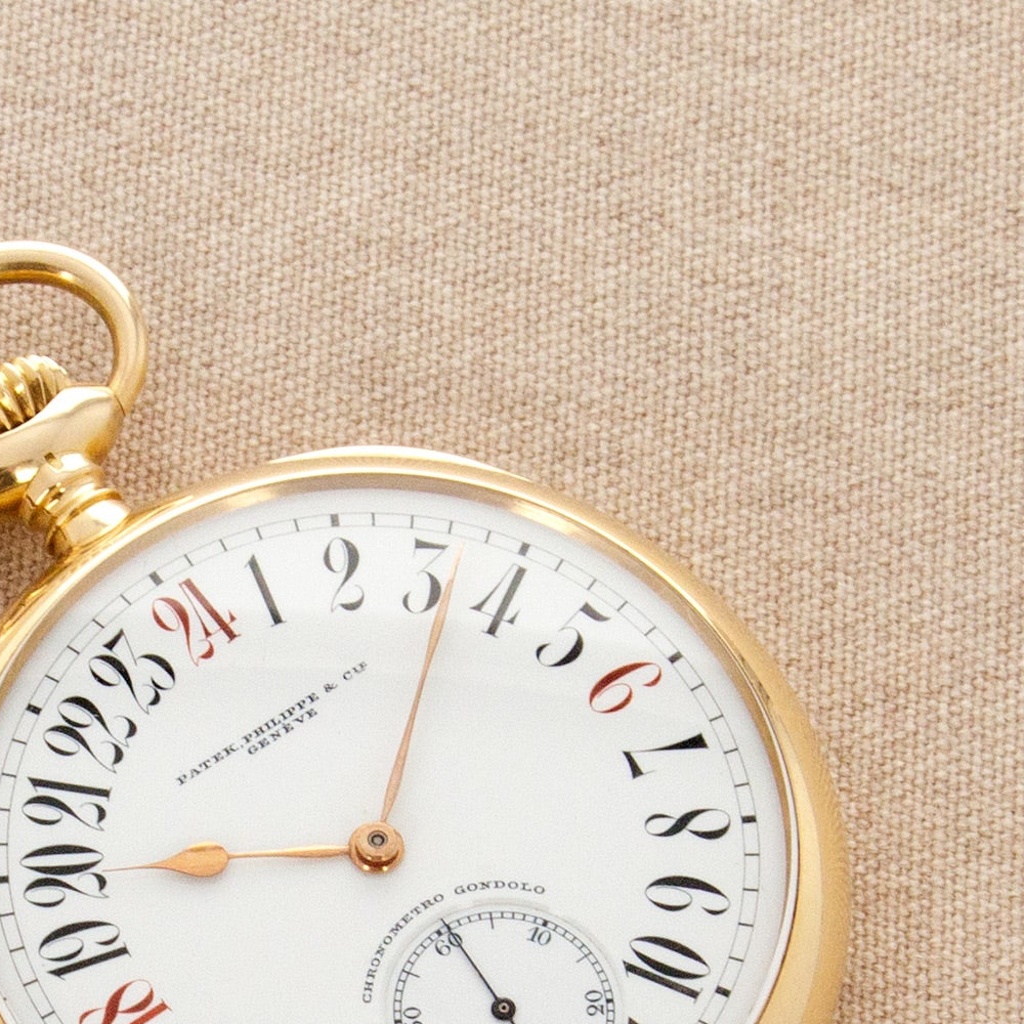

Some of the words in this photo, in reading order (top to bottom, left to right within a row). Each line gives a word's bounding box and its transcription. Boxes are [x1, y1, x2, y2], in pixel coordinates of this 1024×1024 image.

[244, 553, 287, 628] 1
[322, 536, 365, 613] 2
[402, 537, 450, 614] 3
[469, 563, 528, 640] 4
[151, 577, 242, 666] 24
[535, 602, 611, 667] 5
[88, 628, 176, 715] 23
[589, 660, 662, 714] 6
[42, 696, 138, 774] 22
[242, 692, 320, 745] PHILIPPE
[323, 683, 338, 693] &
[247, 708, 318, 756] GENÈVE
[622, 733, 709, 779] 7
[21, 776, 112, 832] 21
[644, 808, 731, 840] 8
[19, 843, 110, 908] 20
[644, 875, 731, 916] 9
[38, 920, 132, 981] 19
[362, 893, 445, 1004] CHRONOMETRO
[454, 880, 546, 896] GONDOLO
[434, 932, 463, 957] 60
[526, 925, 552, 946] 10
[622, 936, 711, 1004] 10
[584, 989, 605, 1017] 20
